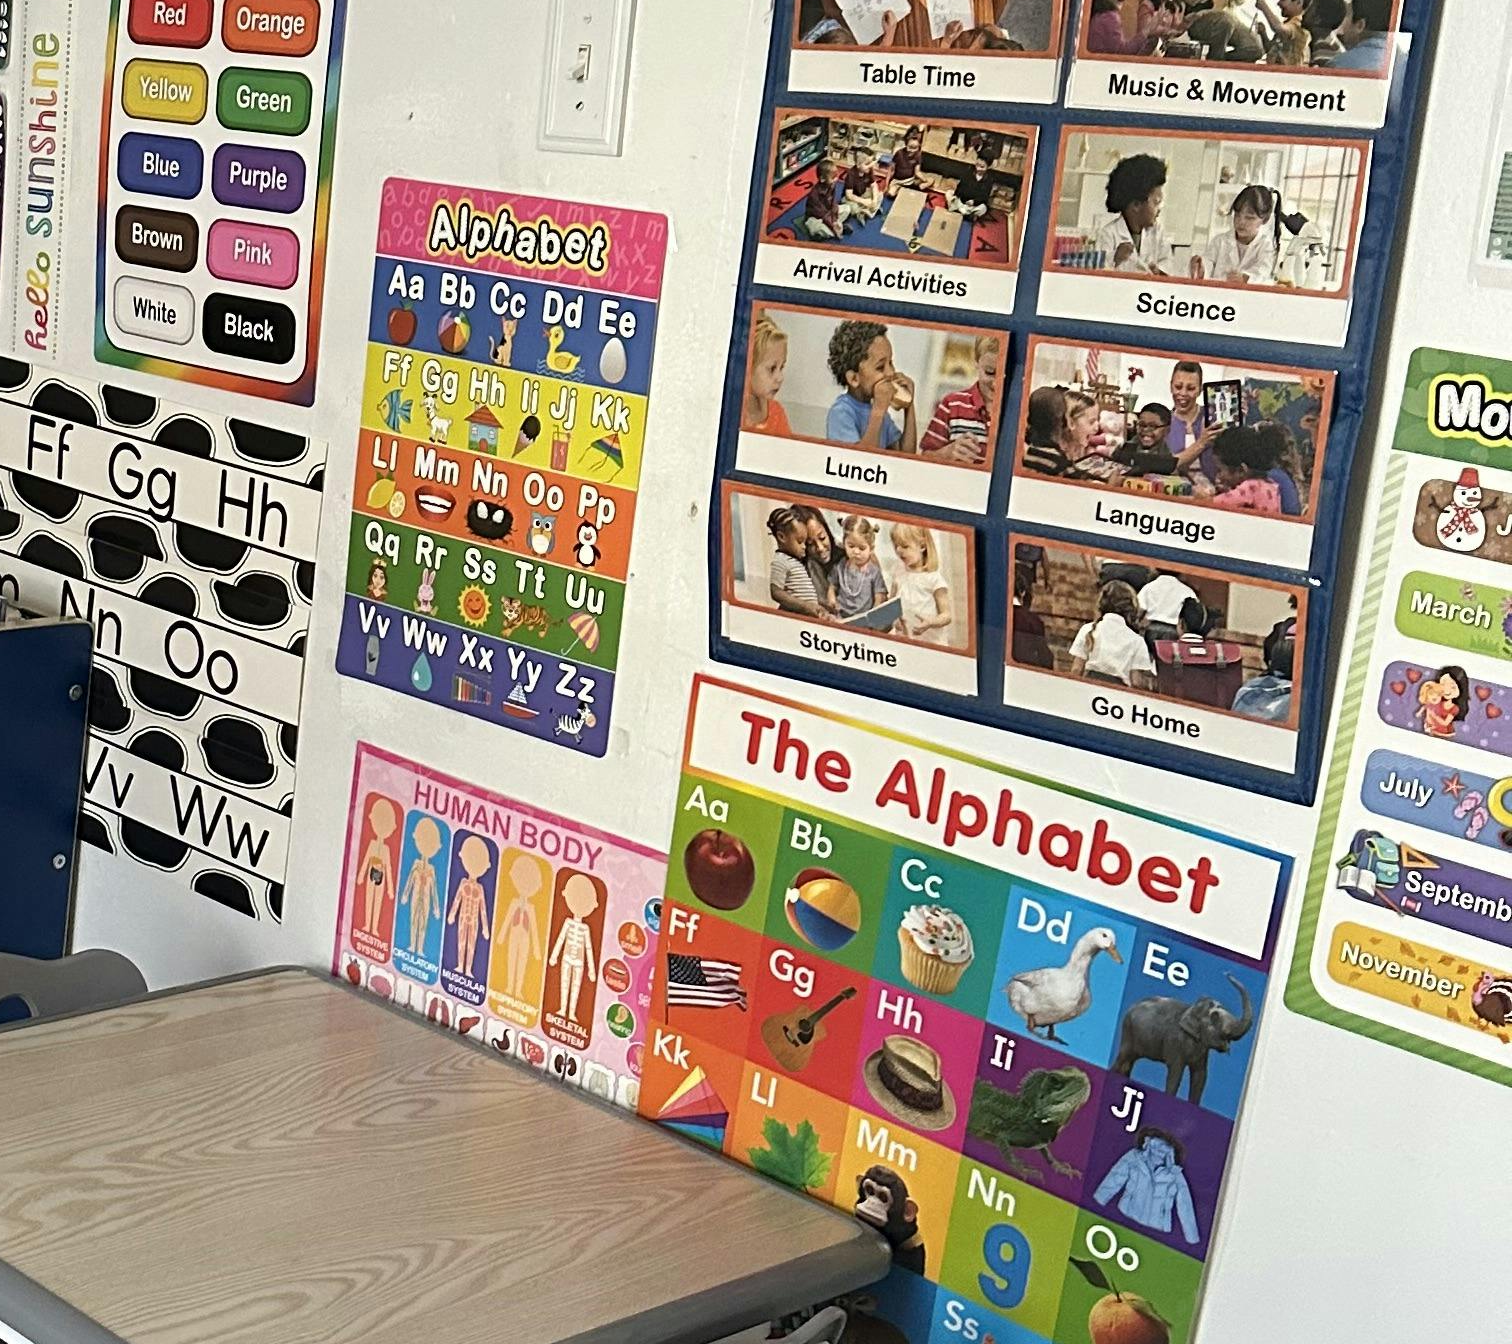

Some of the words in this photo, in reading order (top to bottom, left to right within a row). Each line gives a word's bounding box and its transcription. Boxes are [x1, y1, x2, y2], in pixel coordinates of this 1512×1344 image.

[152, 2, 186, 27] Red
[236, 7, 305, 38] Orange
[140, 75, 192, 104] Yellow
[859, 63, 917, 86] Table
[923, 66, 977, 88] Time
[1107, 73, 1180, 102] Music
[1187, 79, 1204, 101] &
[1212, 81, 1347, 113] Movement
[236, 85, 292, 113] Green
[26, 33, 61, 237] sunshine
[142, 151, 180, 178] Blue
[229, 162, 288, 192] Purple
[131, 224, 183, 252] Brown
[233, 239, 272, 266] Pink
[427, 203, 609, 273] Alphabet
[793, 259, 864, 286] Arrival
[867, 265, 968, 298] Activities
[25, 251, 52, 352] hello
[133, 297, 177, 327] White
[1135, 293, 1237, 323] Science
[224, 313, 275, 342] Black
[825, 457, 889, 485] Lunch
[107, 444, 177, 517] Gg
[217, 469, 289, 548] Hh
[1094, 501, 1217, 543] Language
[1409, 590, 1492, 630] March
[798, 630, 898, 669] Storytime
[1090, 696, 1125, 720] Go
[1130, 703, 1201, 738] Home
[1378, 770, 1434, 807] July
[414, 780, 511, 839] HUMAN
[519, 821, 603, 870] BODY
[741, 709, 851, 793] The
[876, 758, 1220, 915] Alphabet
[1339, 941, 1464, 1001] November
